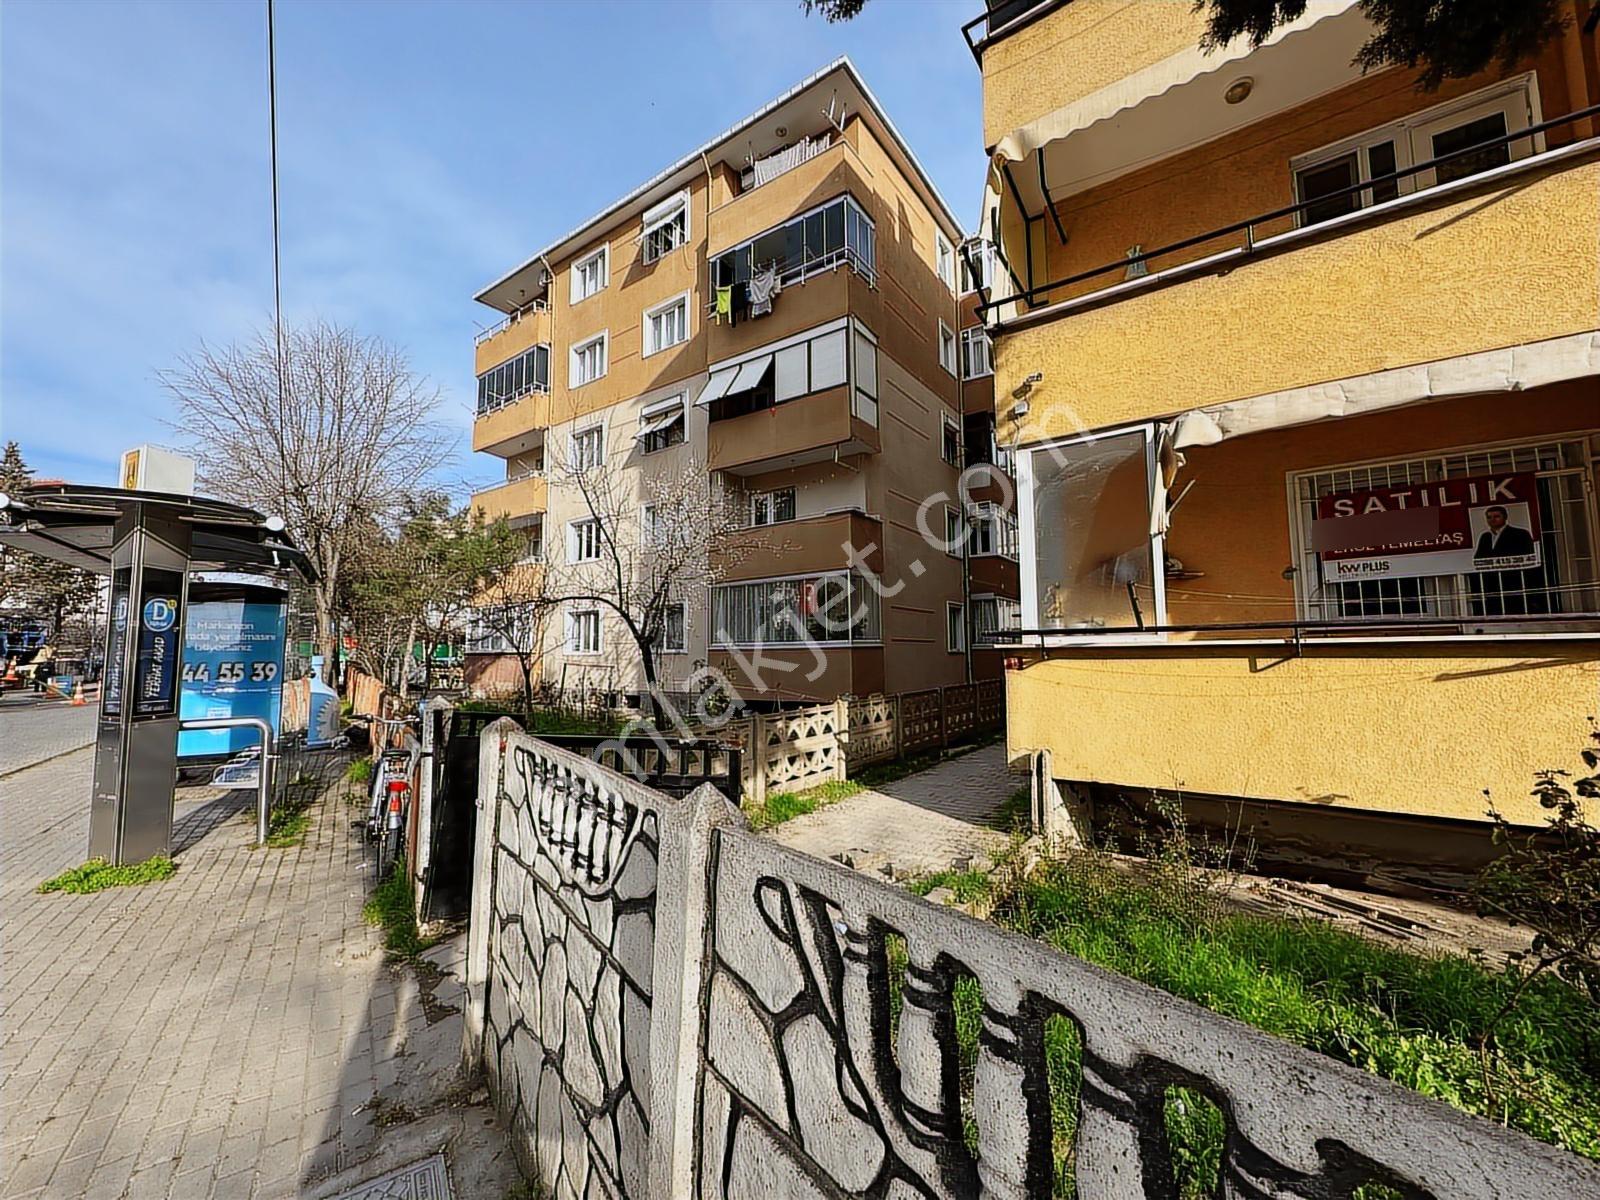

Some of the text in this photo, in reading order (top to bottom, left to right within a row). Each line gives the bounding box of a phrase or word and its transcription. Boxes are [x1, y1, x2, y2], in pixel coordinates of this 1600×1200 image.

[1333, 478, 1517, 518] SATILIK
[1362, 561, 1390, 572] PLUS
[182, 663, 278, 683] 44 55 39
